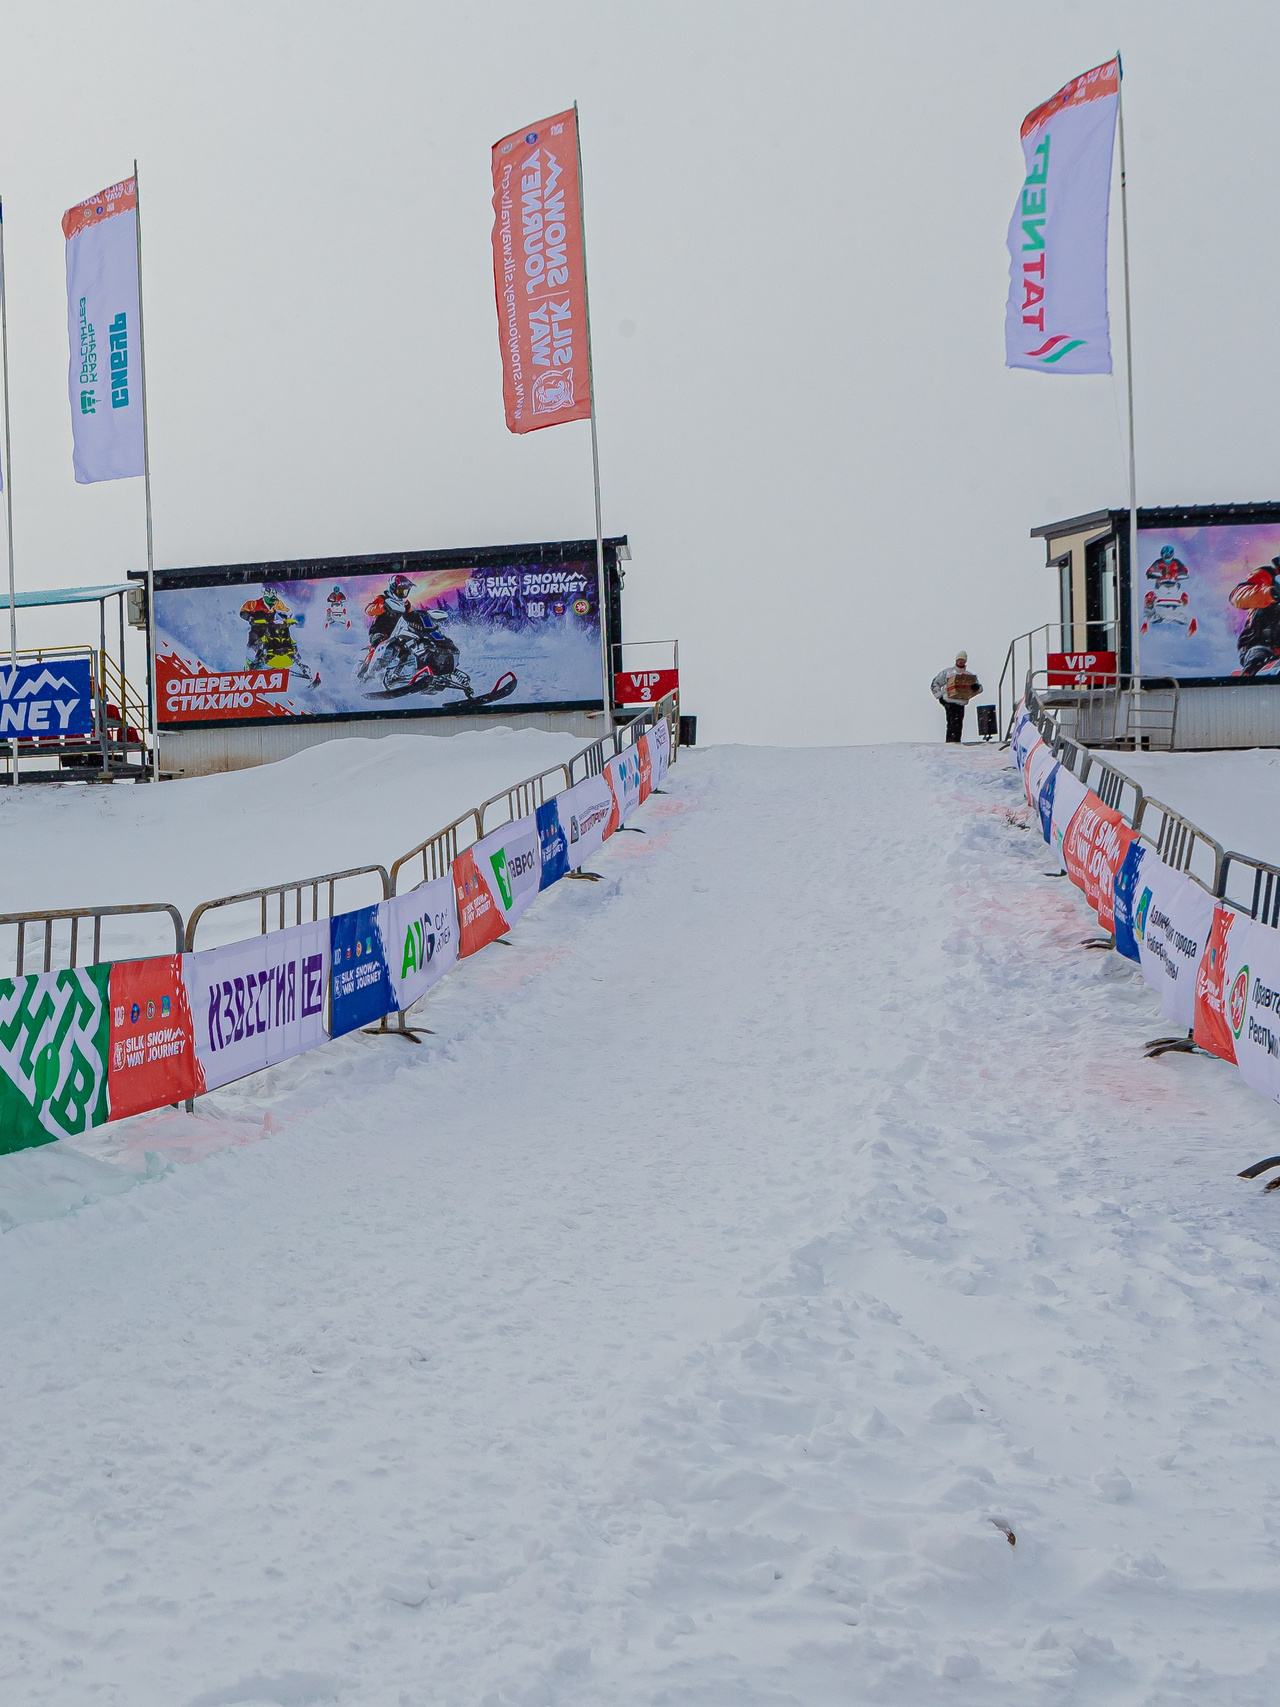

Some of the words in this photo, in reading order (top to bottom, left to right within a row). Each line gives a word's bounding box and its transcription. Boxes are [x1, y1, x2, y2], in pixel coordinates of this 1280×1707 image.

[487, 576, 518, 587] SILK
[523, 571, 567, 585] SNOW
[487, 586, 518, 598] WAY
[523, 581, 588, 595] JOURNEY
[1065, 655, 1096, 669] VIP
[166, 673, 283, 695] ОПЕРЕЖАЯ
[630, 673, 660, 687] VIP
[166, 692, 254, 712] СТИХИЮ
[640, 687, 651, 700] 3
[401, 912, 436, 980] AVG
[208, 960, 296, 1052] ИЗВЕСТИЯ
[126, 1035, 144, 1053] SILK
[147, 1028, 172, 1047] SNOW
[126, 1050, 145, 1068] WAY
[147, 1040, 186, 1062] JOURNEY
